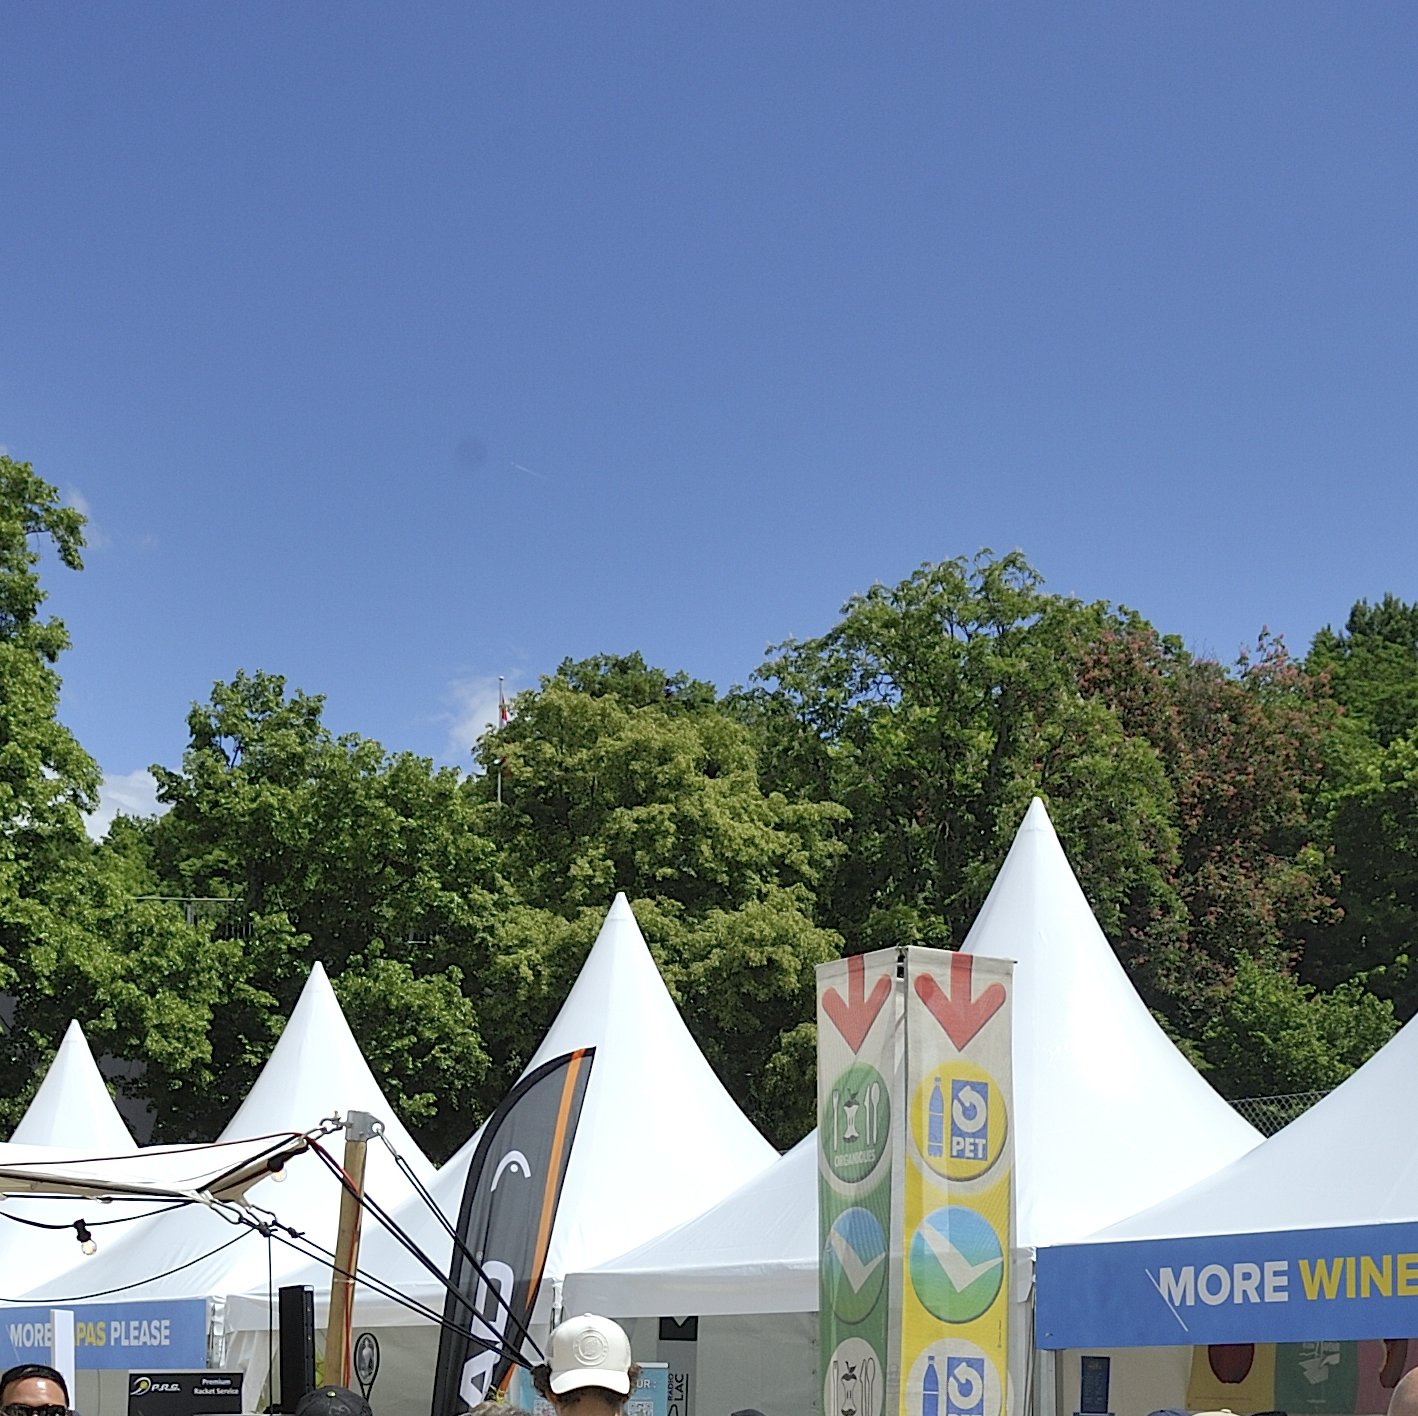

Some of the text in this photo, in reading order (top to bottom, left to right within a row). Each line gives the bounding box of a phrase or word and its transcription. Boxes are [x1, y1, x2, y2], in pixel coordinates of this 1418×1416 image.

[834, 1149, 876, 1168] ORGANIQUES
[951, 1136, 986, 1159] PET
[1159, 1260, 1289, 1307] MORE
[10, 1319, 170, 1348] MORE PAS PLEASE
[674, 1374, 684, 1400] LAC
